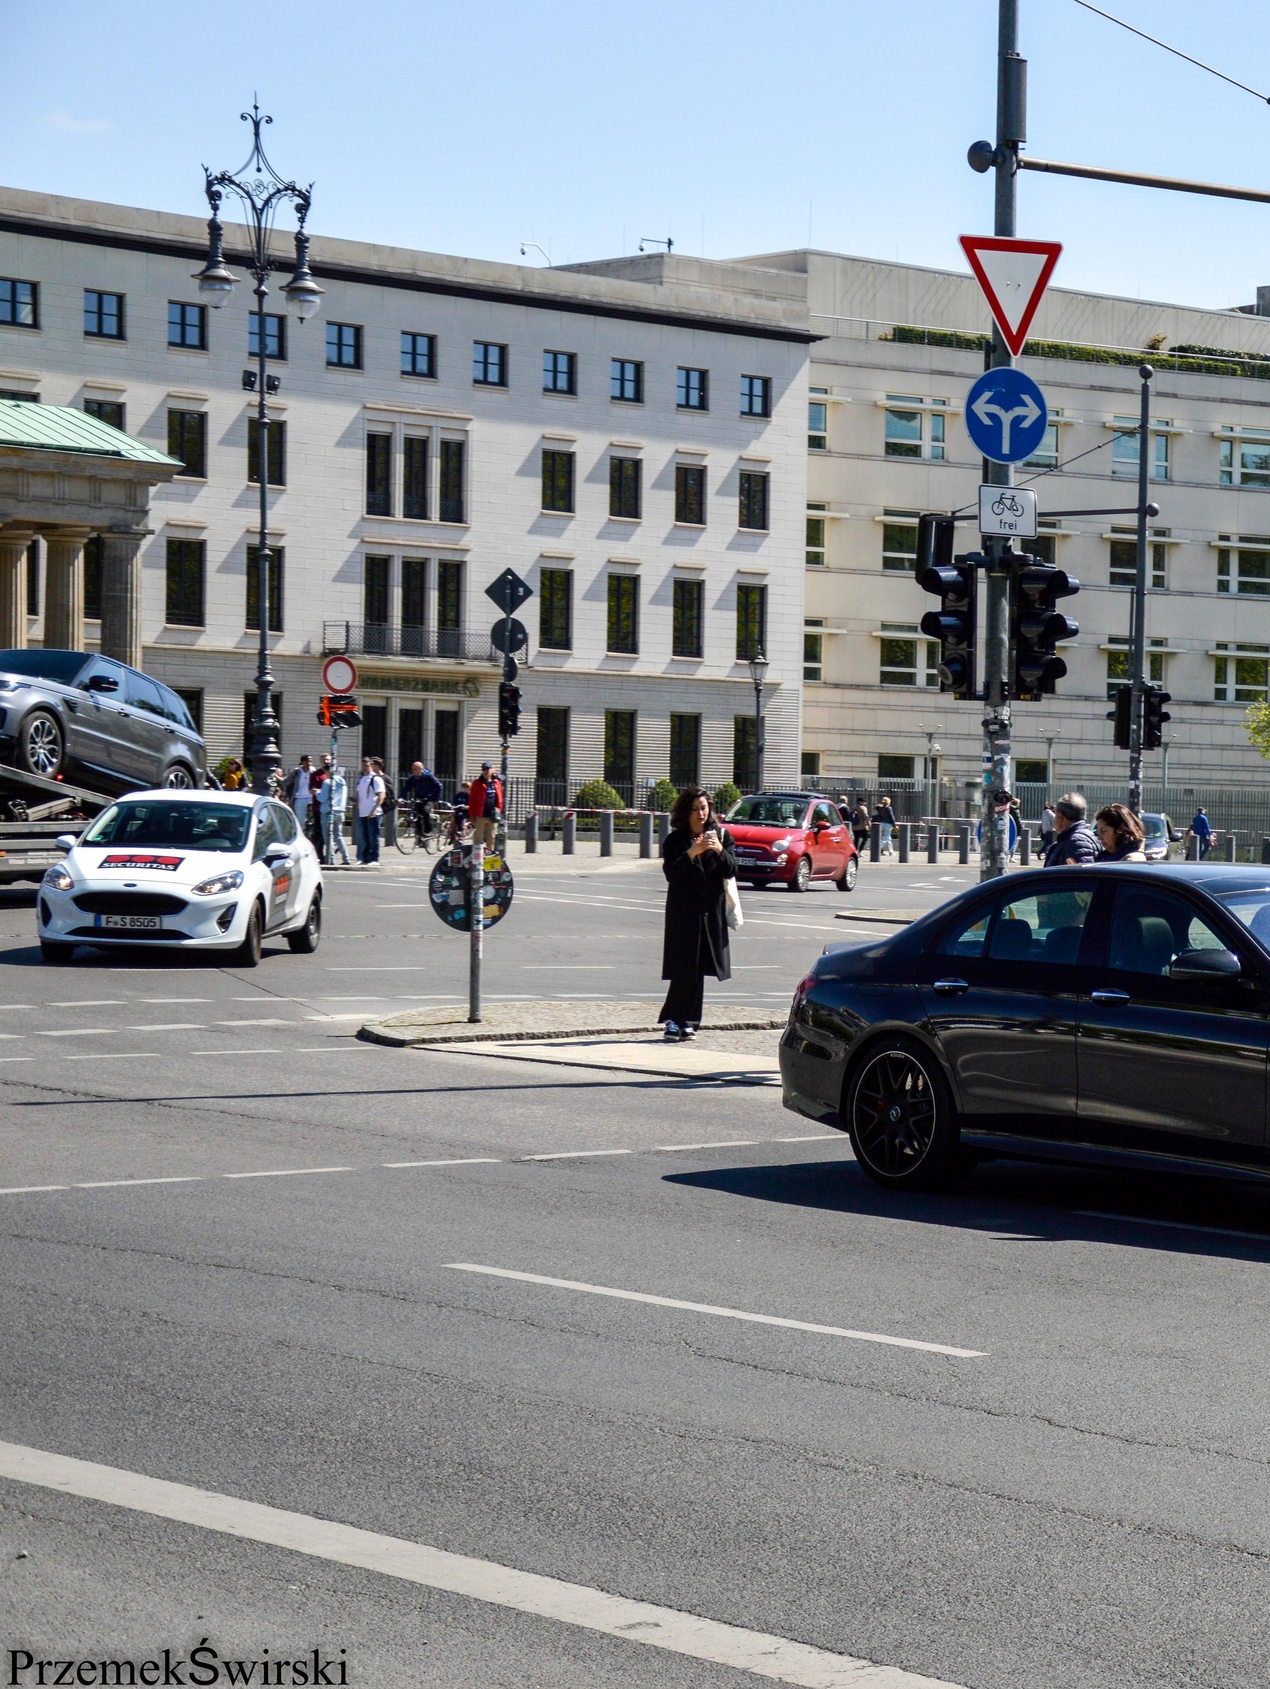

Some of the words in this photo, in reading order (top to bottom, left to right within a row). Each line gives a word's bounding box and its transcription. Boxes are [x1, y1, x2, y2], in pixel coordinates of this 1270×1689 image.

[999, 519, 1018, 530] frei
[101, 862, 176, 870] SECURITAS
[105, 916, 113, 926] F
[120, 917, 127, 927] S
[129, 918, 157, 927] 8505
